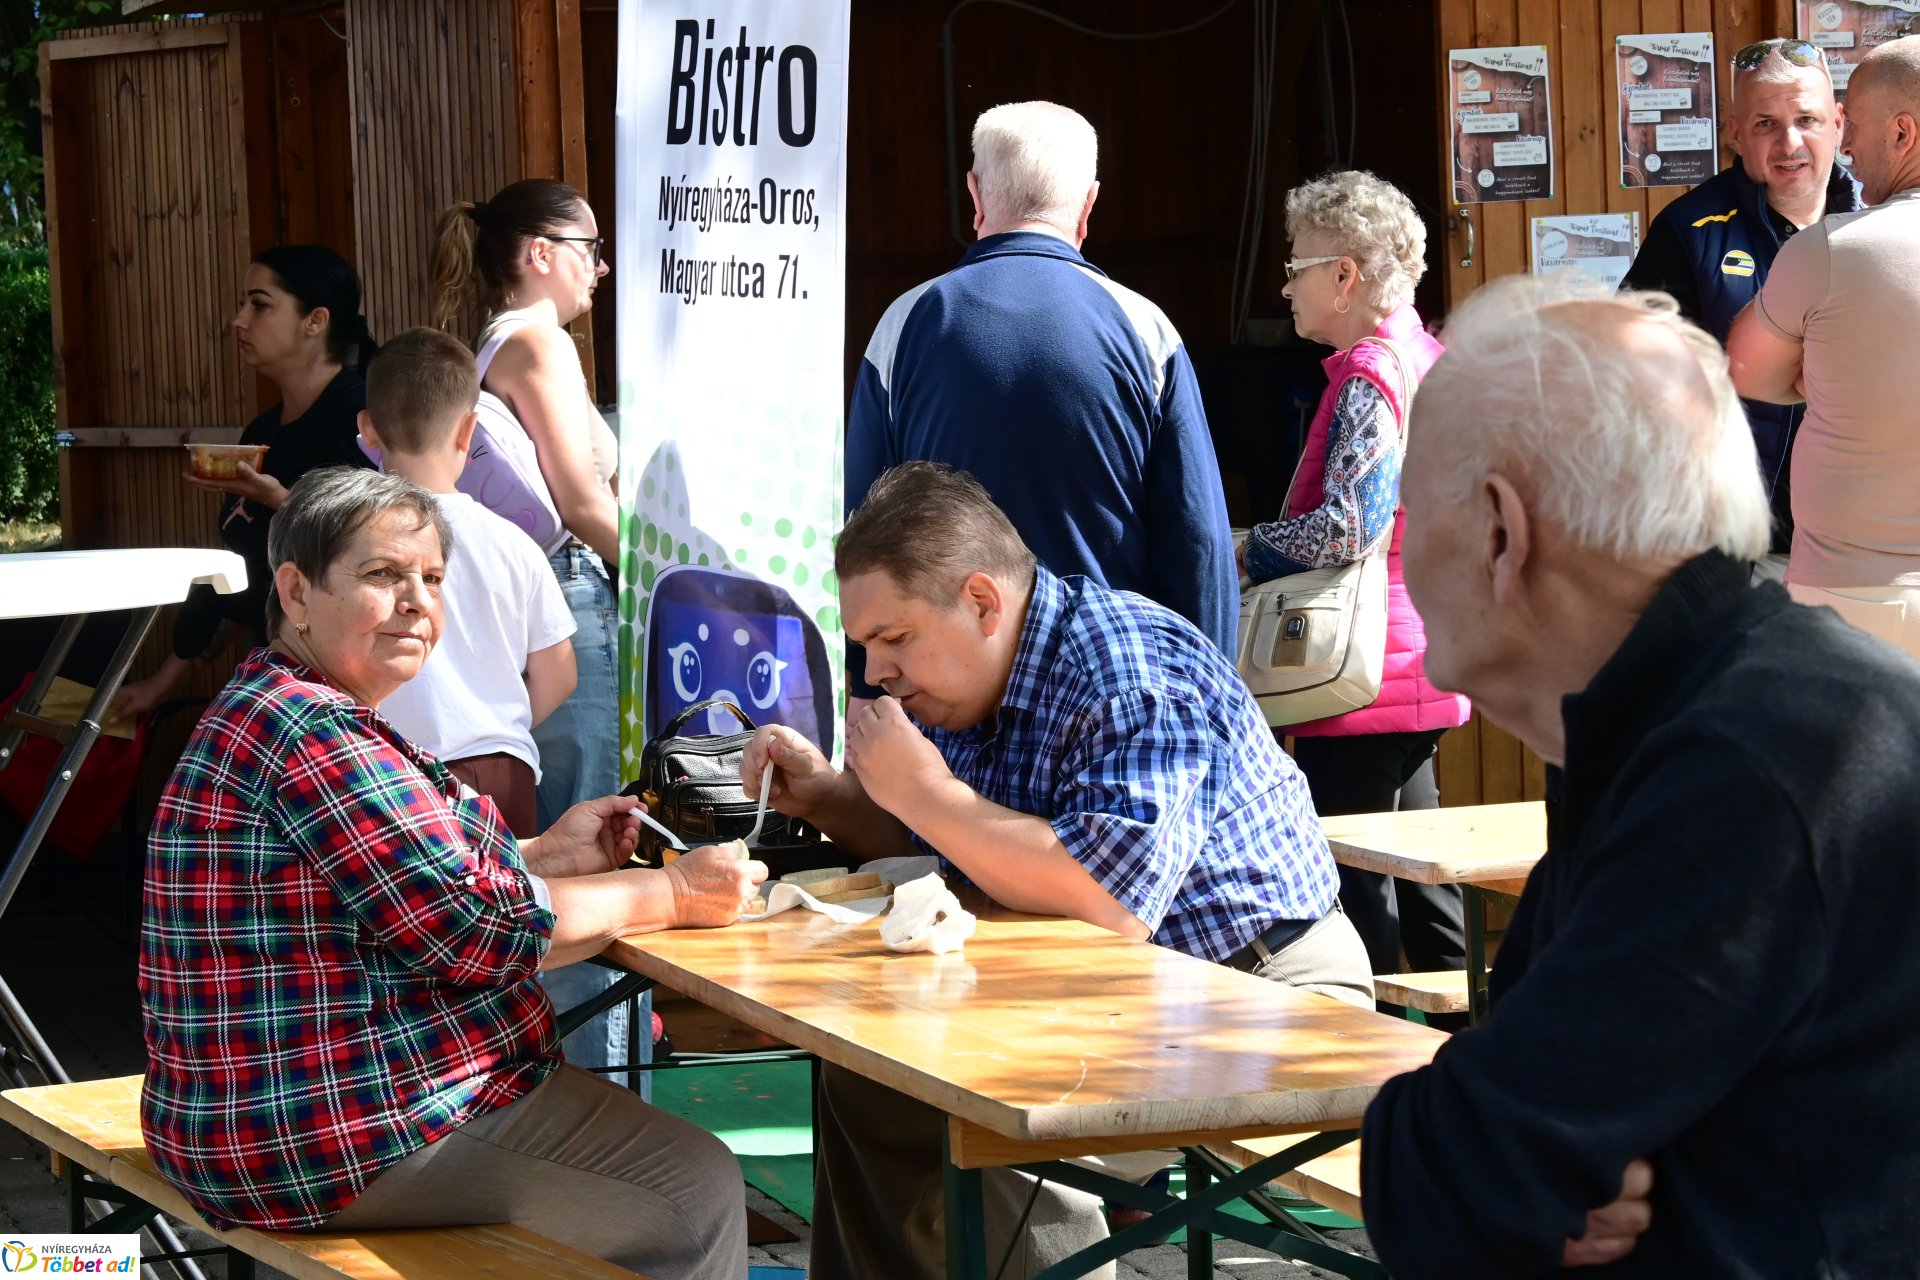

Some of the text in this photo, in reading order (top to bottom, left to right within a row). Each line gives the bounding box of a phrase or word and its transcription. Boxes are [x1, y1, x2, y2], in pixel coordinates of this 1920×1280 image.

[666, 19, 818, 148] Bistro
[658, 174, 820, 233] Nyíregyháza-Oros,
[660, 248, 809, 305] Magyar utca 71.
